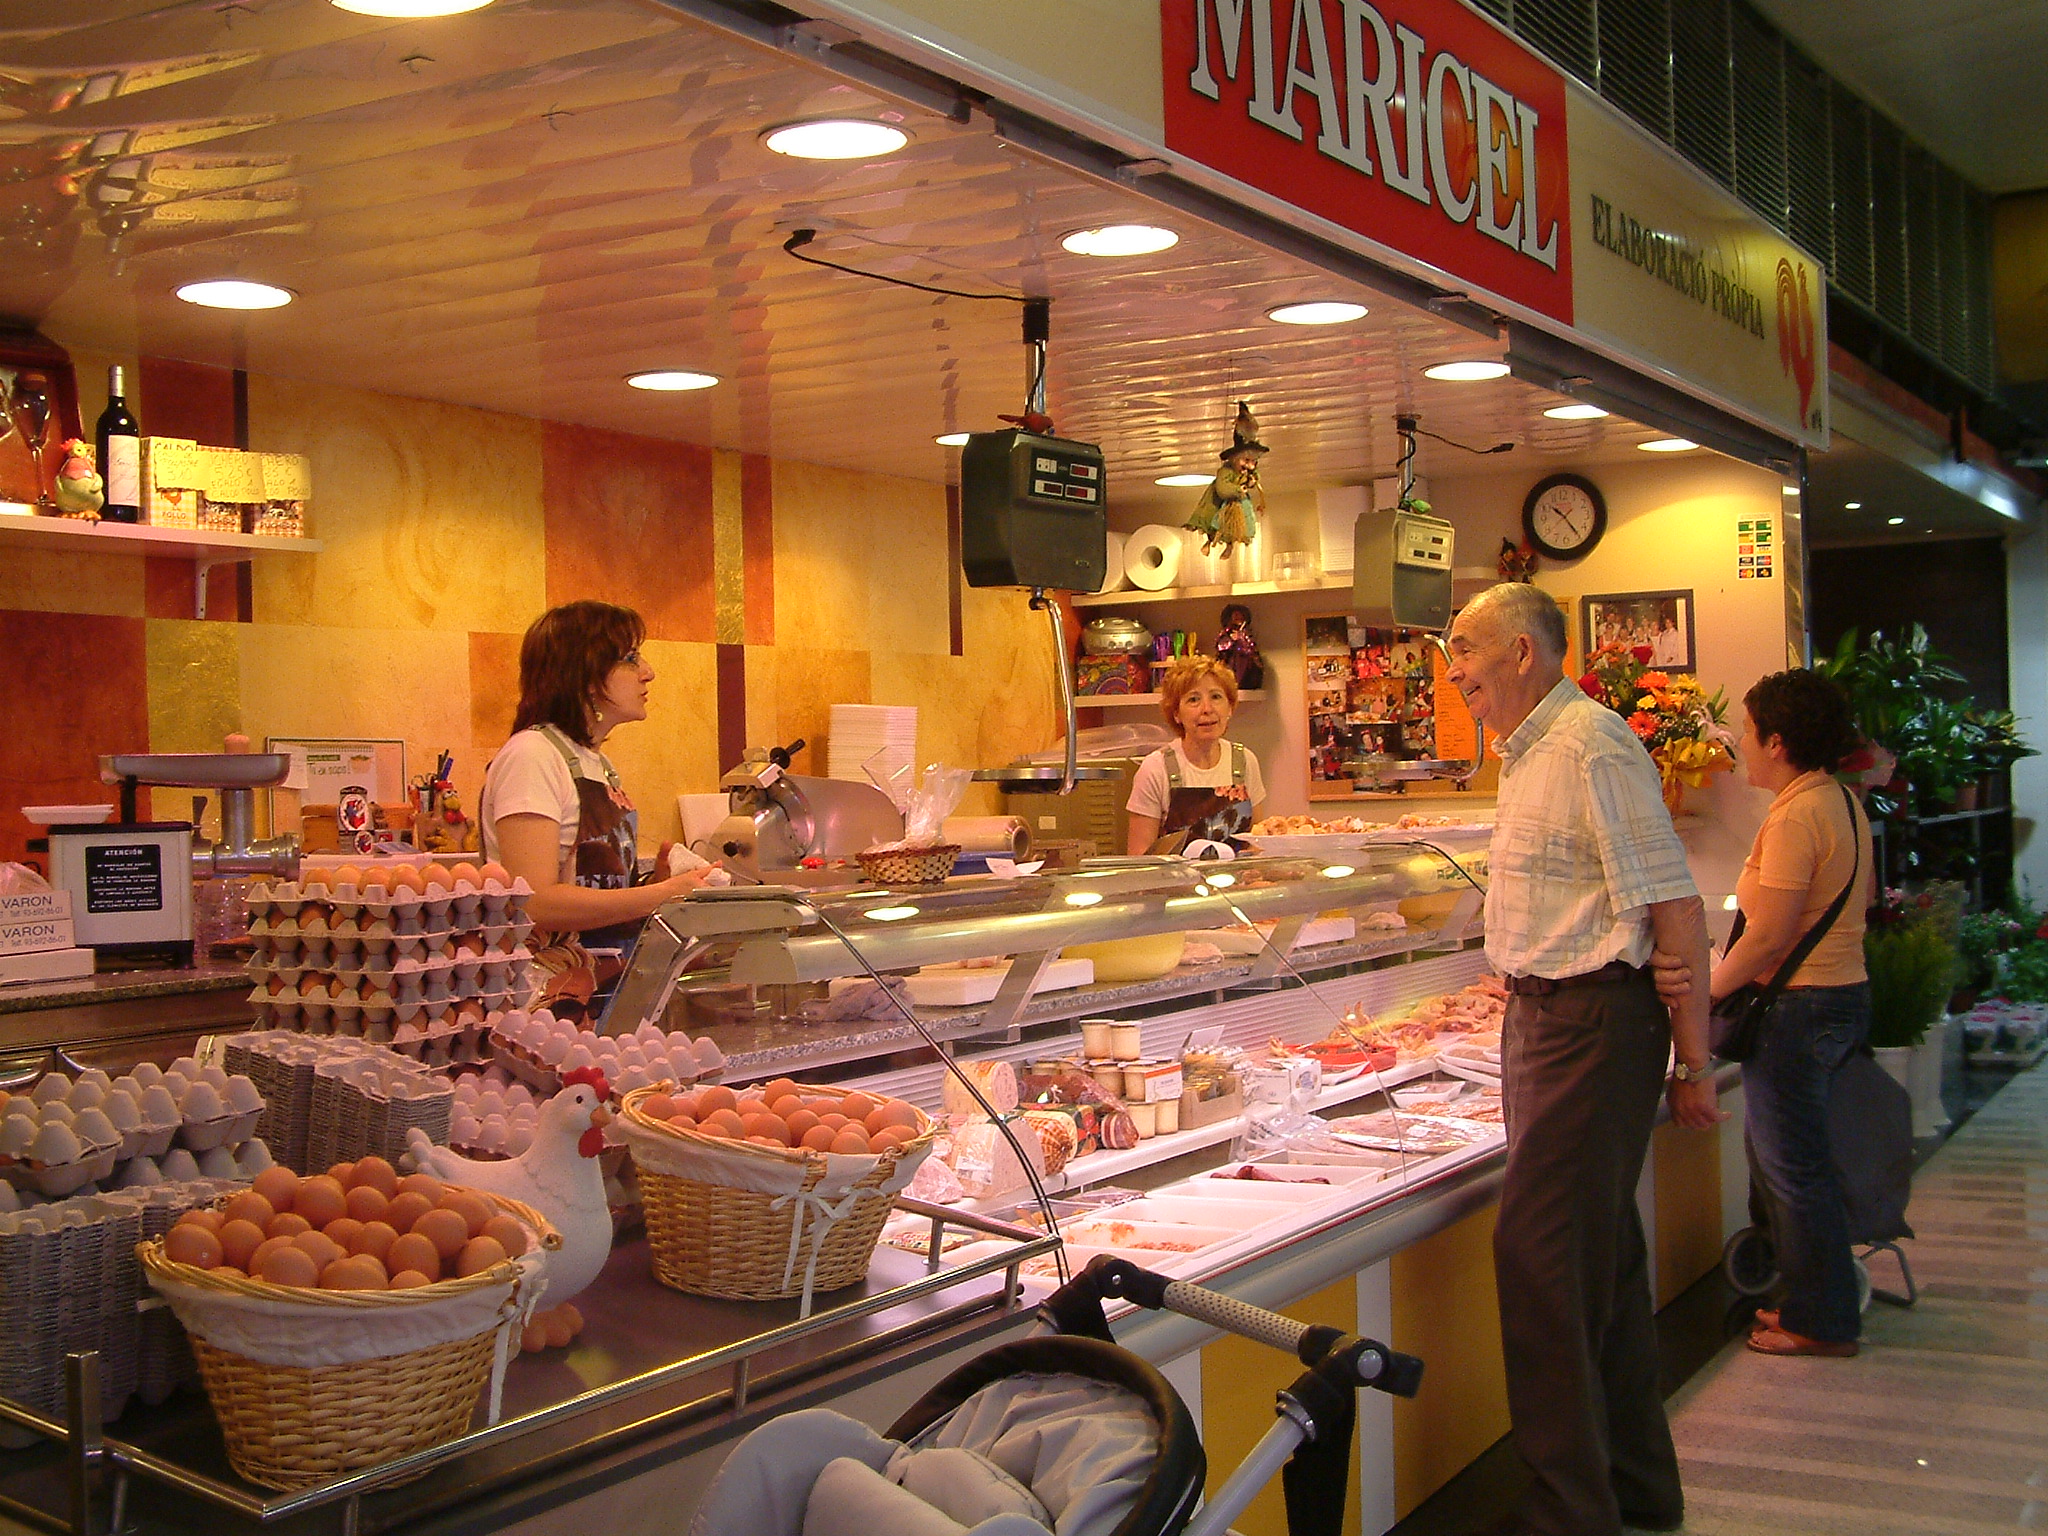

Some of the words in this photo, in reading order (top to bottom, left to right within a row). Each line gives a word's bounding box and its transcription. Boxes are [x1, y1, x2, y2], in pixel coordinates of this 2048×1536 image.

[1190, 0, 1559, 272] MARICEL
[1591, 194, 1707, 304] ELABORACIÓ
[1711, 270, 1765, 340] PRÒPIA
[2, 896, 52, 909] VARON
[2, 924, 55, 938] VARON
